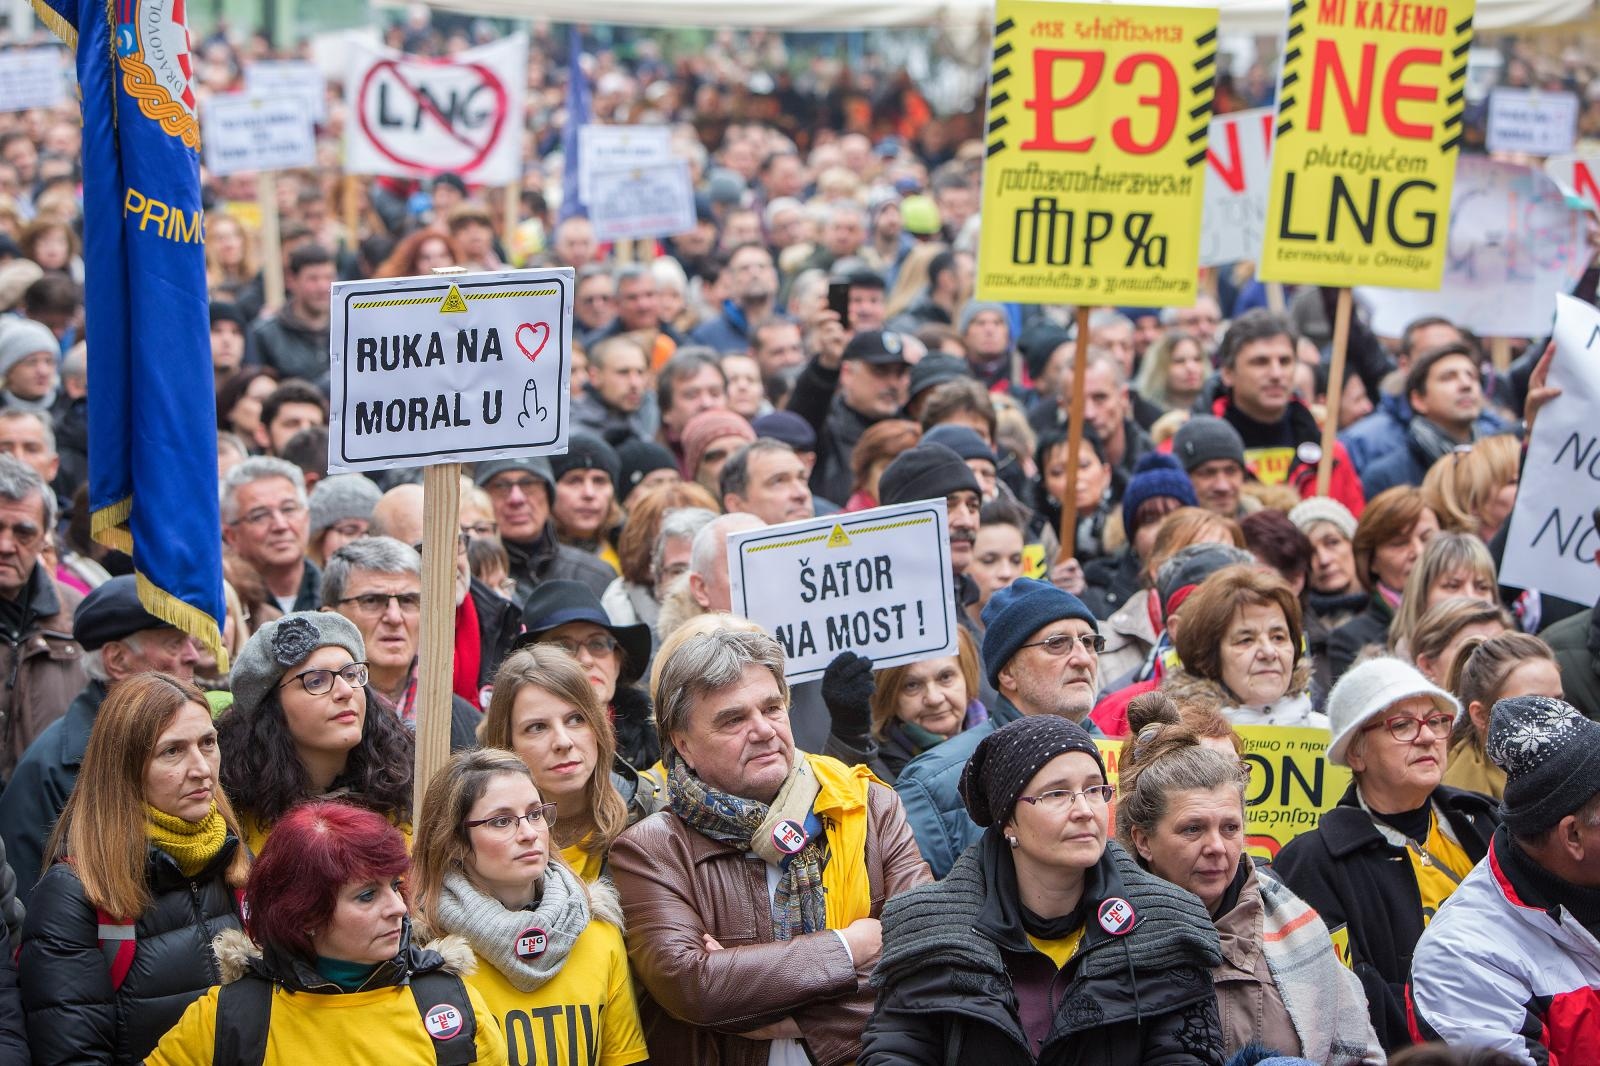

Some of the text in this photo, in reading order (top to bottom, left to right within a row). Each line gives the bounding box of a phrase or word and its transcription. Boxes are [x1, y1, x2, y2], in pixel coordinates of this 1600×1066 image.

[1318, 0, 1448, 37] MI KAŽEMO
[378, 82, 491, 131] LNG
[1305, 38, 1443, 141] NE
[1303, 144, 1428, 176] plutajućem
[1279, 172, 1438, 250] LNG
[356, 327, 503, 373] RUKA NA
[355, 389, 503, 436] MORAL U
[798, 554, 893, 604] ŠATOR
[775, 600, 926, 659] NA MOST !
[1104, 903, 1124, 923] LNG
[522, 936, 544, 947] LNG
[431, 1011, 456, 1025] LNG
[492, 1003, 605, 1066] OTIV
